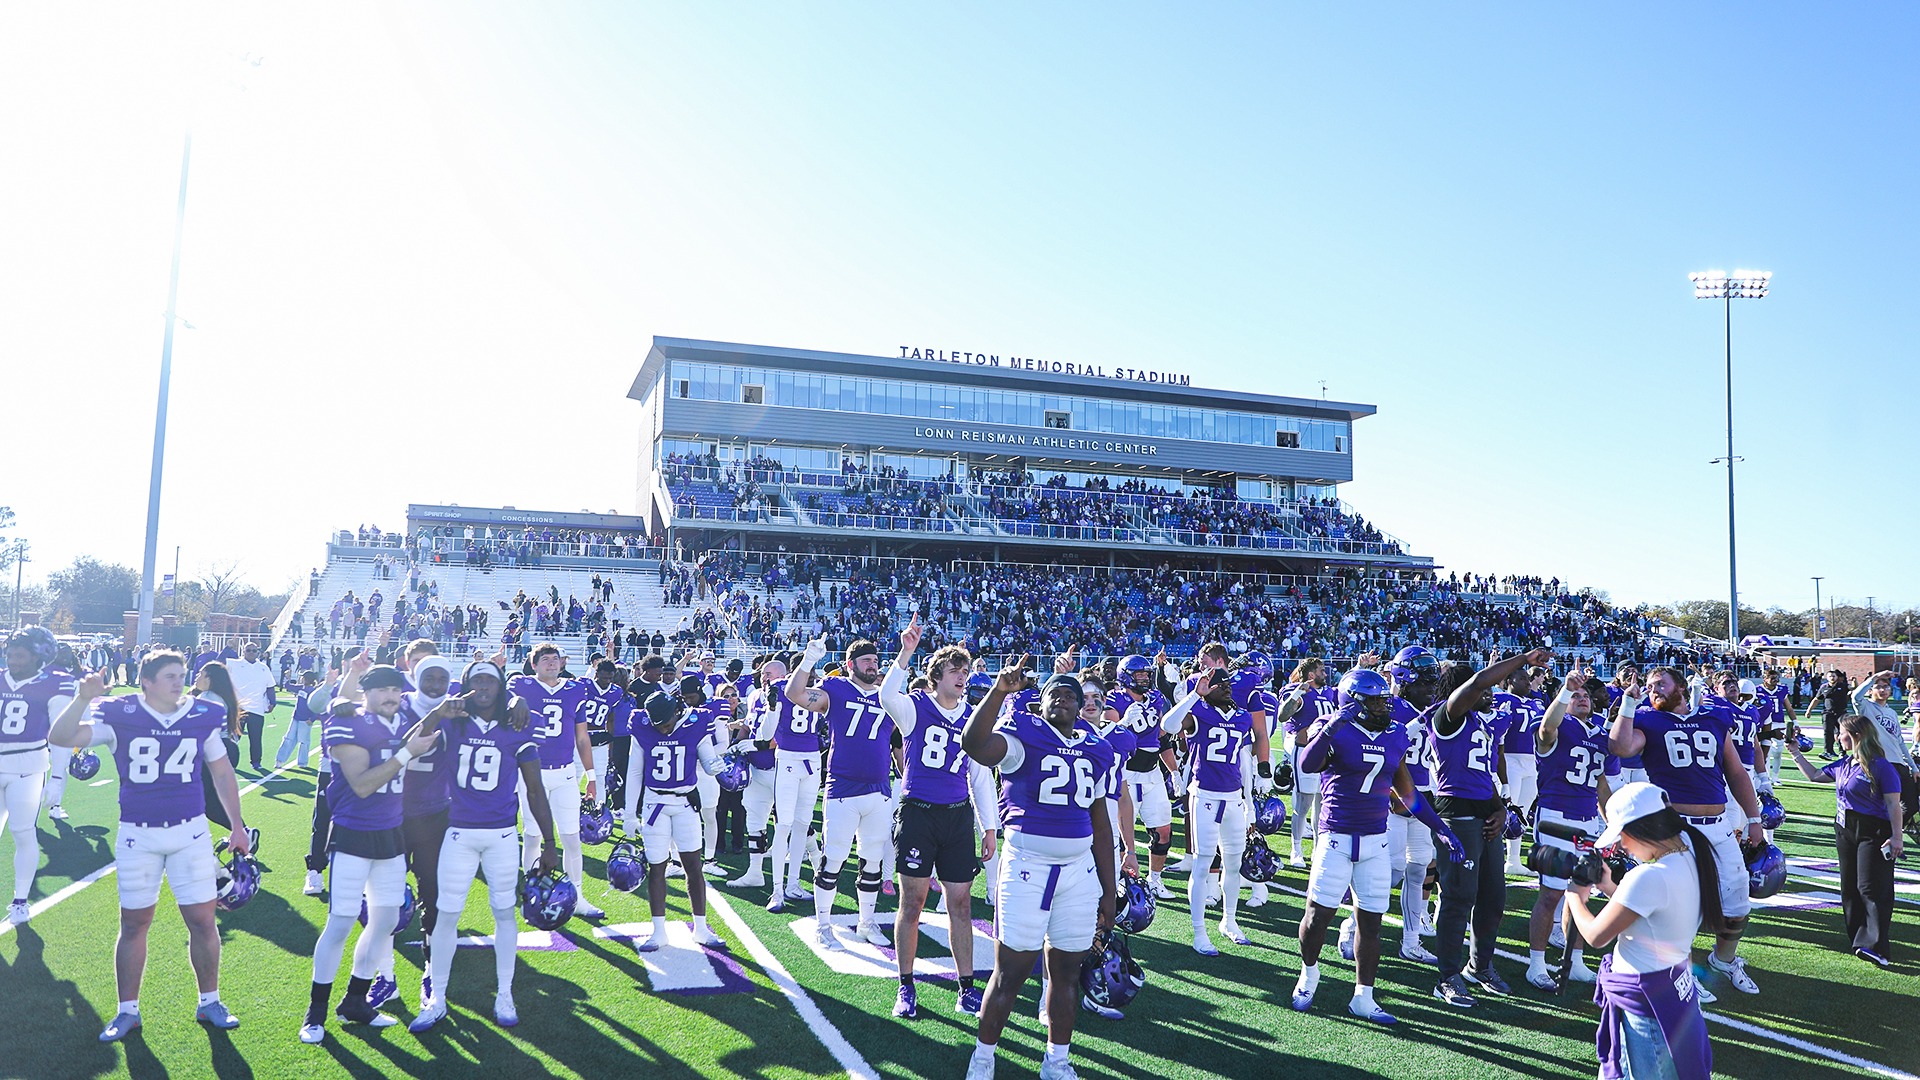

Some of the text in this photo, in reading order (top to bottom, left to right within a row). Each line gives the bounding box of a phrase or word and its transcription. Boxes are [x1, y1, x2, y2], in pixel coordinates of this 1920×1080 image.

[900, 346, 1190, 386] TARLETON MEMORIAL STADIUM
[915, 427, 1157, 455] LONN REISMAN ATHLETIC CENTER
[502, 515, 553, 524] CONCESSIONS
[585, 700, 609, 726] 28
[857, 697, 876, 706] TEXANS
[543, 705, 563, 737] 3
[845, 701, 886, 740] 77
[469, 737, 495, 746] TEXANS
[921, 725, 967, 774] 87
[1057, 747, 1083, 756] TEXANS
[1206, 727, 1243, 764] 27
[1361, 744, 1386, 752] TEXANS
[1664, 730, 1717, 768] 69
[129, 737, 198, 784] 84
[457, 744, 502, 791] 19
[651, 745, 686, 781] 31
[1359, 752, 1386, 794] 7
[1566, 745, 1606, 788] 32
[1038, 754, 1095, 809] 26
